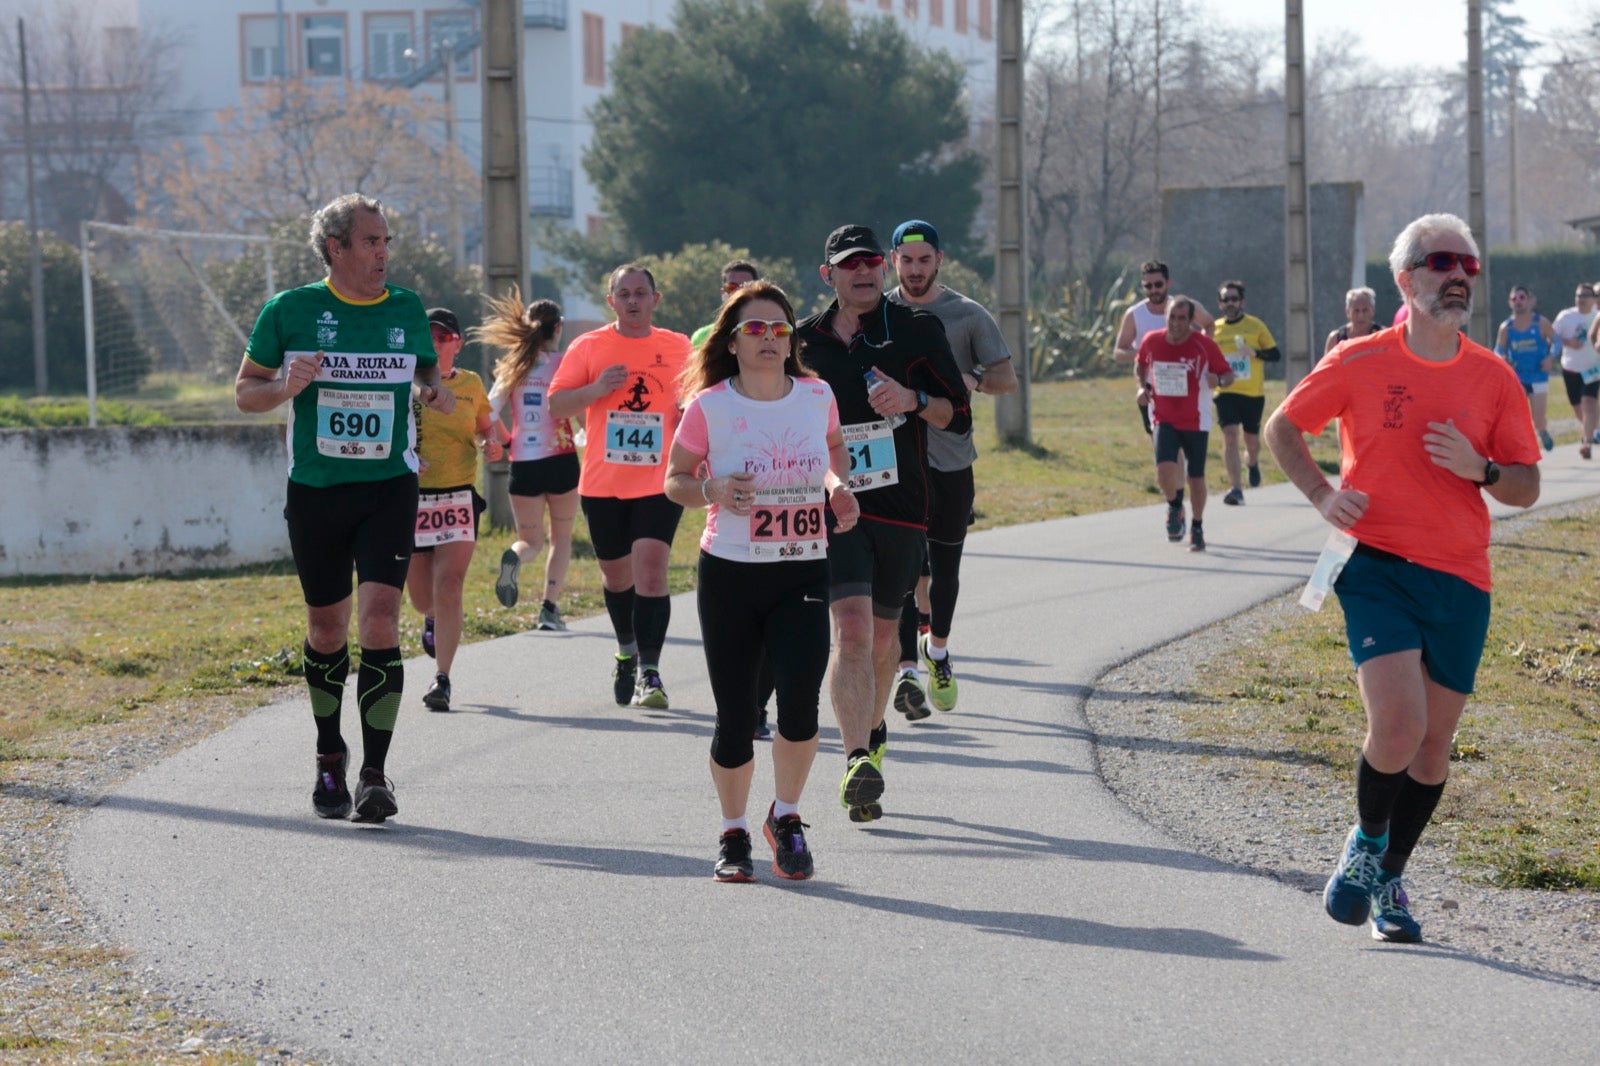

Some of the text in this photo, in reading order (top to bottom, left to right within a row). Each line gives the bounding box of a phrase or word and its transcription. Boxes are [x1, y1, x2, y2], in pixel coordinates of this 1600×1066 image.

[320, 356, 407, 370] AJA RURAL
[331, 370, 387, 380] GRANADA
[329, 411, 380, 438] 690
[615, 428, 654, 449] 144
[744, 460, 767, 473] Por
[787, 455, 822, 472] mujer
[417, 506, 471, 531] 2063
[754, 507, 821, 537] 2169
